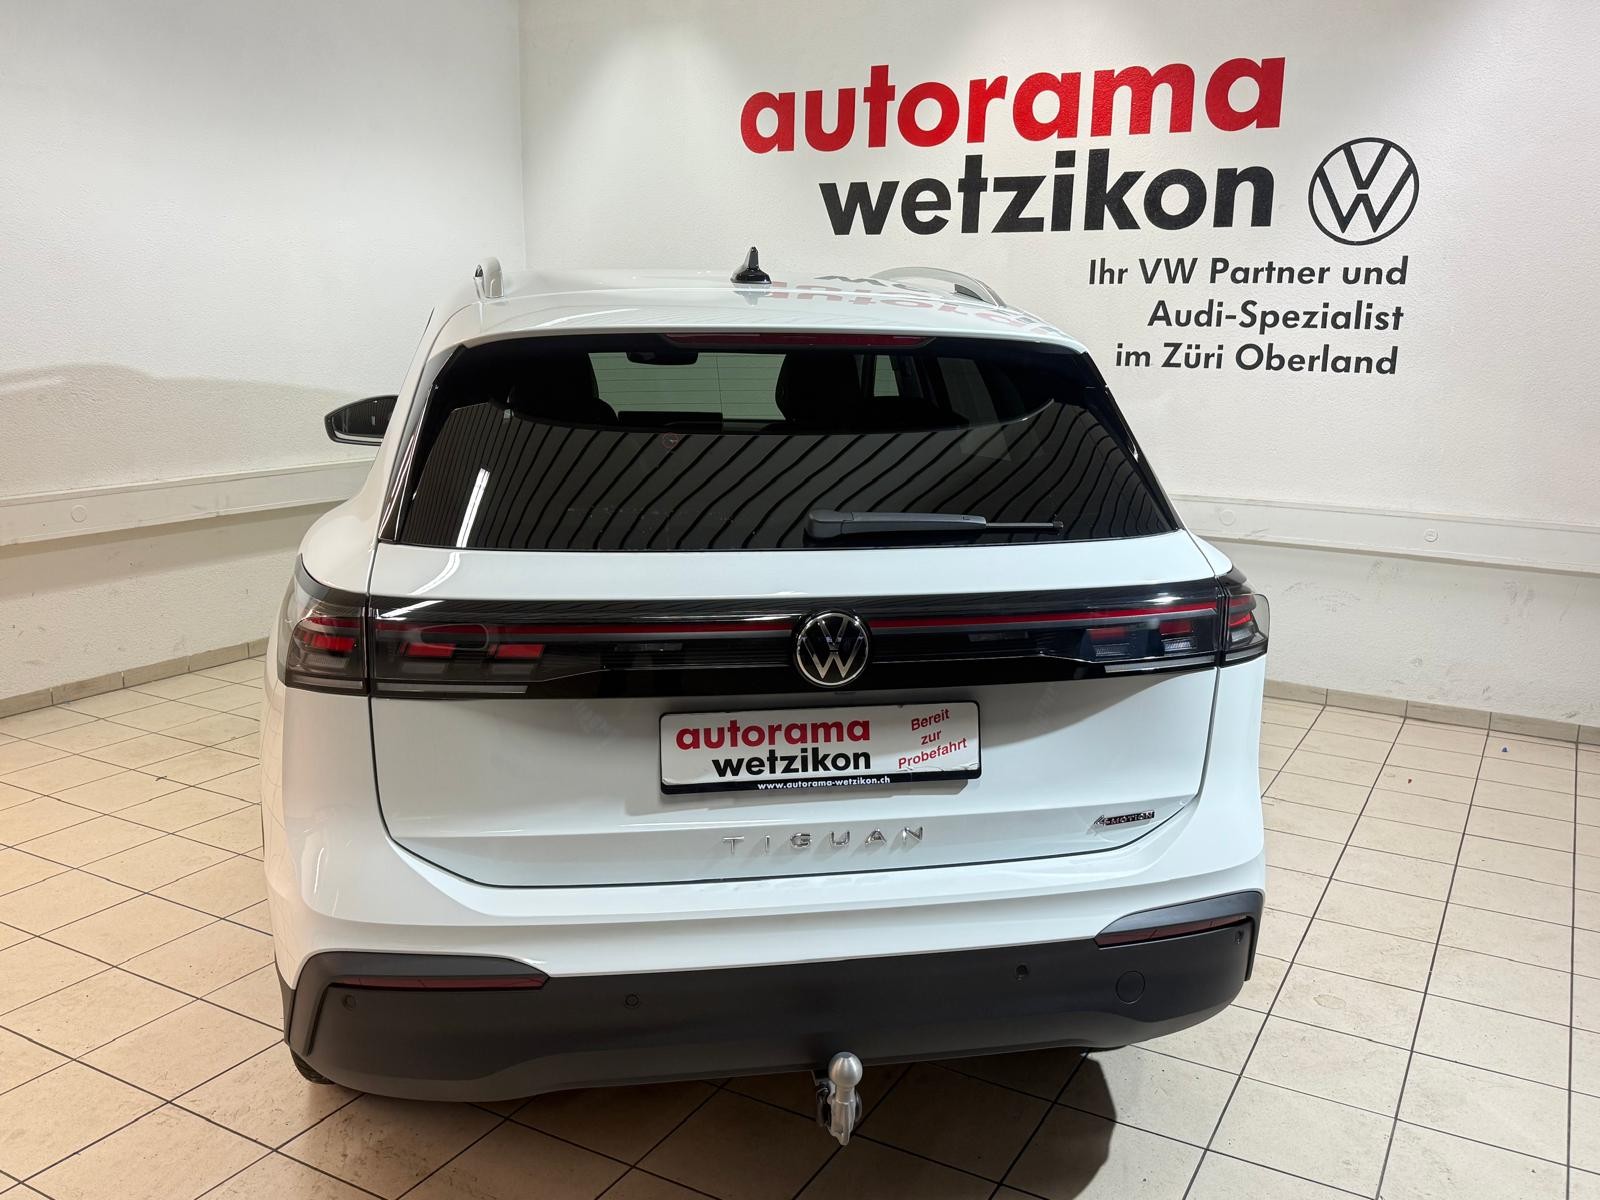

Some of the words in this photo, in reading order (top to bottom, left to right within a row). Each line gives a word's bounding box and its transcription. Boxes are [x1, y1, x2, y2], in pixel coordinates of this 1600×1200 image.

[740, 57, 1287, 155] autorama
[818, 148, 1275, 236] wetzikon
[1308, 137, 1419, 245] VW
[1089, 257, 1129, 285] Ihr
[1138, 257, 1199, 285] VW
[1209, 257, 1331, 285] Partner
[1342, 255, 1409, 285] und
[1147, 298, 1405, 335] Audi-Spezialist
[1115, 342, 1151, 368] im
[1160, 342, 1224, 370] Züri
[1235, 342, 1399, 375] Oberland
[675, 719, 871, 751] autorama
[910, 708, 951, 732] Bereit
[920, 728, 943, 746] zur
[711, 747, 871, 778] wetzikon
[897, 737, 968, 770] Probefahrt
[757, 775, 891, 791] www.autorama-wetzikon.ch
[722, 825, 924, 854] TIGUAN
